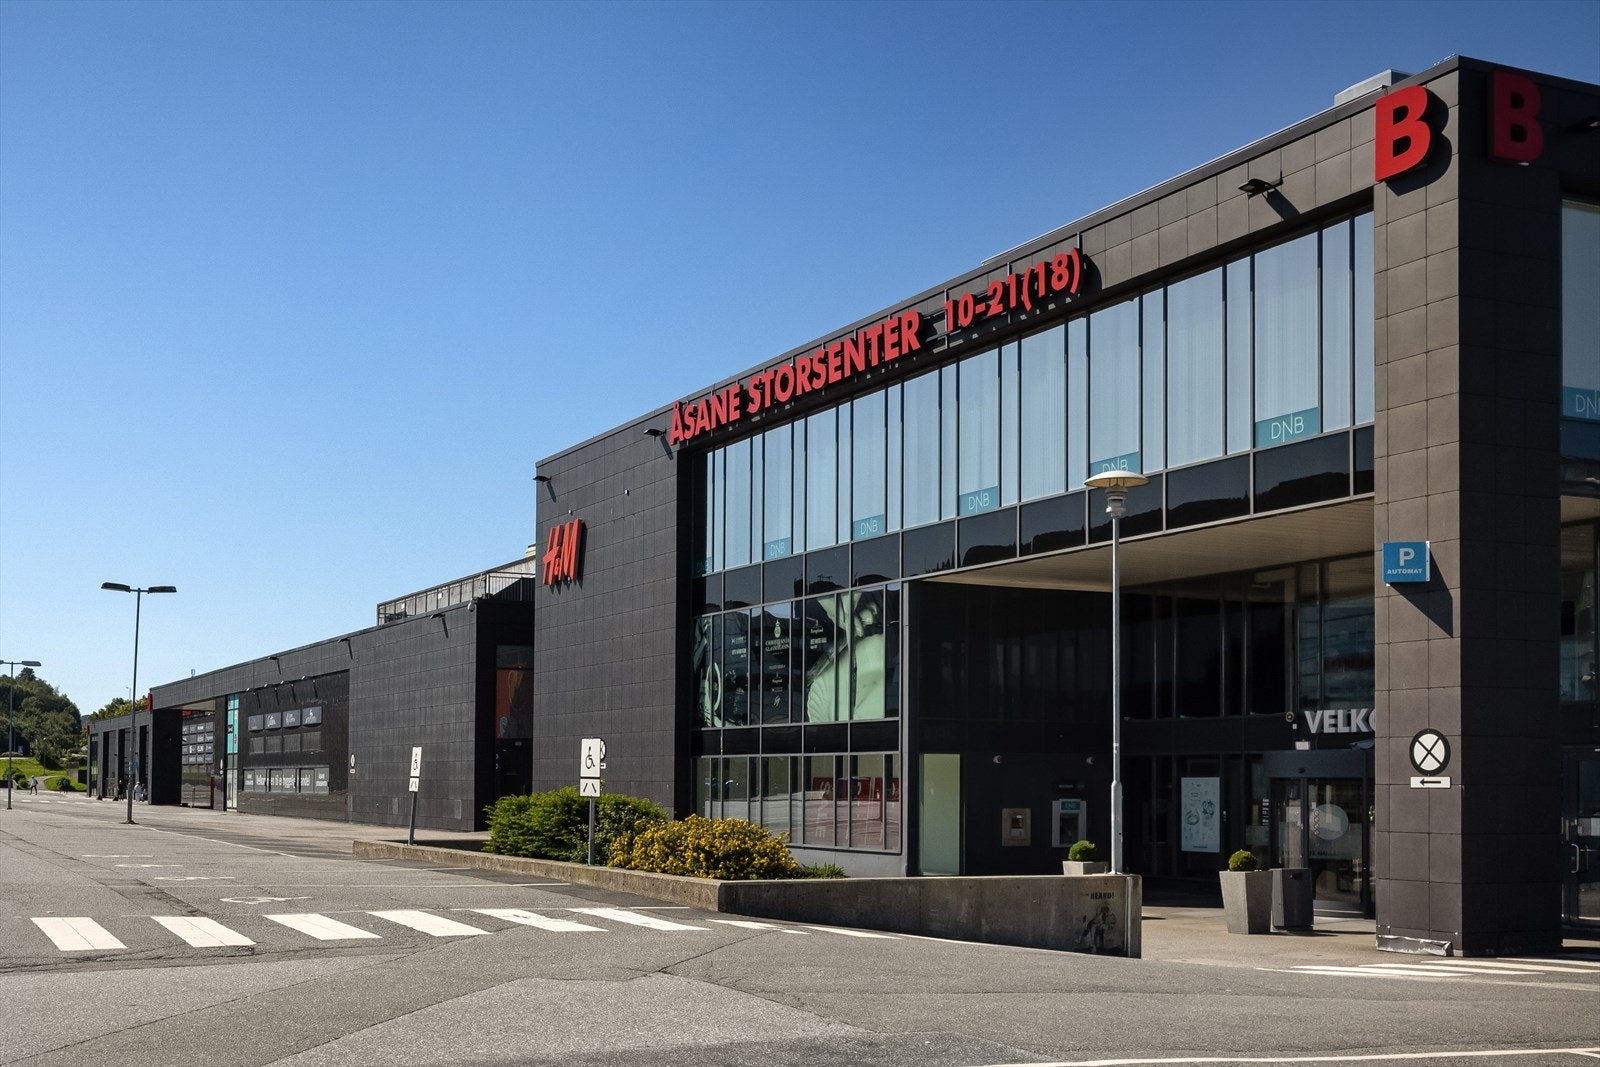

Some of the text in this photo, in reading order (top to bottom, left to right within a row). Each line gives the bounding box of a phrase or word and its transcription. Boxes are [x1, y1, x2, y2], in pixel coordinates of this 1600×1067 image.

[1493, 70, 1544, 162] B
[1375, 84, 1431, 182] B
[669, 247, 1081, 446] ÅSANE STORSENTER 10-21(18)
[1271, 412, 1304, 442] DNB
[968, 491, 990, 513] DNB
[860, 517, 878, 536] DNB
[543, 519, 580, 586] H&M
[770, 541, 786, 558] DNB
[1399, 547, 1415, 566] P
